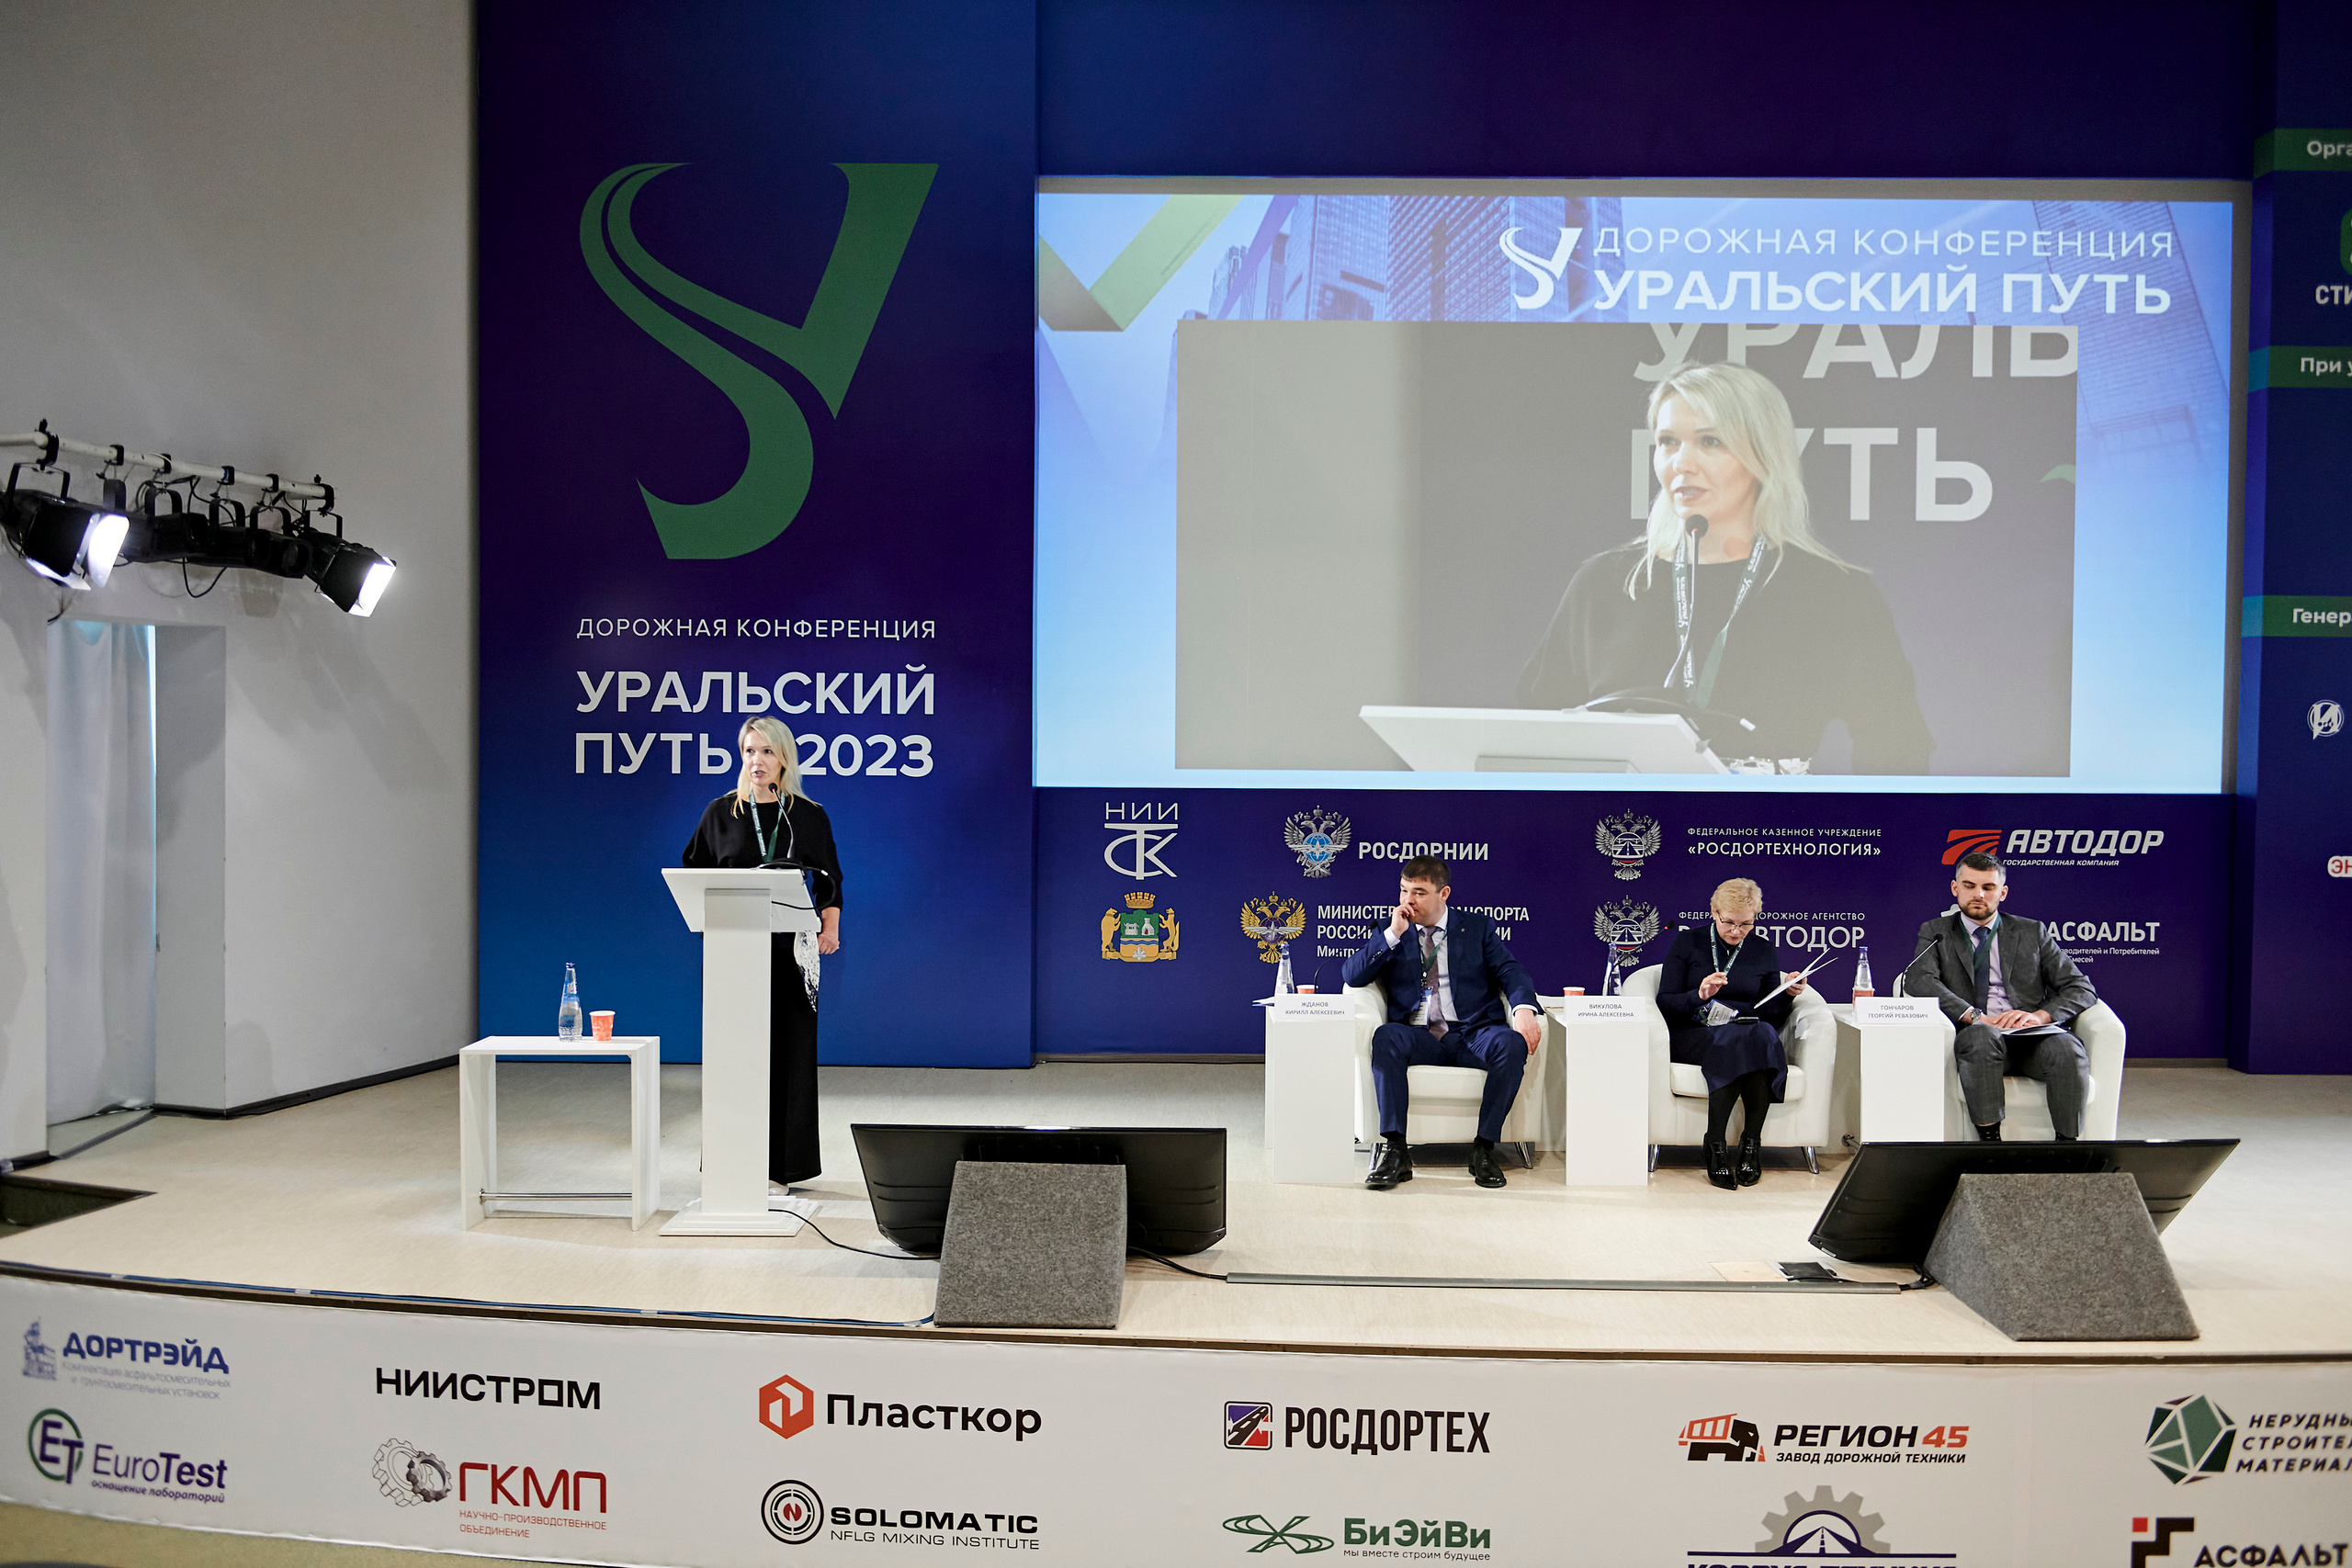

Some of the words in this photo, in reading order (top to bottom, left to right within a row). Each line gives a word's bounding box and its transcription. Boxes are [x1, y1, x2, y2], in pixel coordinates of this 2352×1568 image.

[1593, 228, 1836, 258] ДОРОЖНАЯ
[1853, 228, 2173, 261] КОНФЕРЕНЦИЯ
[1593, 264, 1976, 312] УРАЛЬСКИЙ
[2003, 274, 2171, 314] ПУТЬ
[2301, 357, 2342, 377] При
[577, 618, 727, 639] ДОРОЖНАЯ
[737, 619, 935, 641] КОНФЕРЕНЦИЯ
[2293, 608, 2352, 627] Генер
[576, 663, 934, 715] УРАЛЬСКИЙ
[575, 732, 732, 775] ПУТЬ
[796, 733, 934, 777] 2023
[1105, 802, 1178, 820] НИИ
[1688, 828, 1758, 836] ФЕДЕРАЛЬНОЕ
[1762, 829, 1815, 837] КАЗЕННОЕ
[1817, 829, 1882, 837] УЧРЕЖДЕНИЕ
[2006, 829, 2165, 856] АВТОДОР
[1359, 841, 1488, 863] РОСДОРНИИ
[1688, 842, 1882, 857] «РОСДОРТЕХНОЛОГИЯ»
[1317, 905, 1396, 919] МИНИСТЕР
[2109, 947, 2160, 956] Потребителей
[62, 1332, 229, 1374] ДОРТРЭЙД
[376, 1367, 600, 1409] НИИСТРОМ
[827, 1393, 1042, 1441] Пласткор
[1285, 1406, 1490, 1456] РОСДОРТЕХ
[1774, 1424, 1918, 1448] РЕГИОН
[1922, 1426, 1970, 1449] 45
[93, 1444, 228, 1489] EuroTest
[1776, 1452, 1820, 1464] ЗАВОД
[1824, 1450, 1900, 1464] ДОРОЖНОЙ
[1905, 1453, 1966, 1463] ТЕХНИКИ
[459, 1461, 606, 1514] ГКМП
[459, 1509, 606, 1530] НАУЧНО-ПРОИЗВОДСТВЕННОЕ
[459, 1524, 530, 1538] ОБЪЕДИНЕНИЕ
[831, 1506, 1038, 1534] SOLOMATIC
[831, 1530, 876, 1542] NFLG
[883, 1532, 944, 1546] MIXING
[952, 1536, 1039, 1550] INSTITUTE
[1344, 1517, 1490, 1549] БиЭйВи
[1362, 1550, 1399, 1558] вместе
[1402, 1551, 1441, 1560] строим
[1444, 1551, 1490, 1562] будущее
